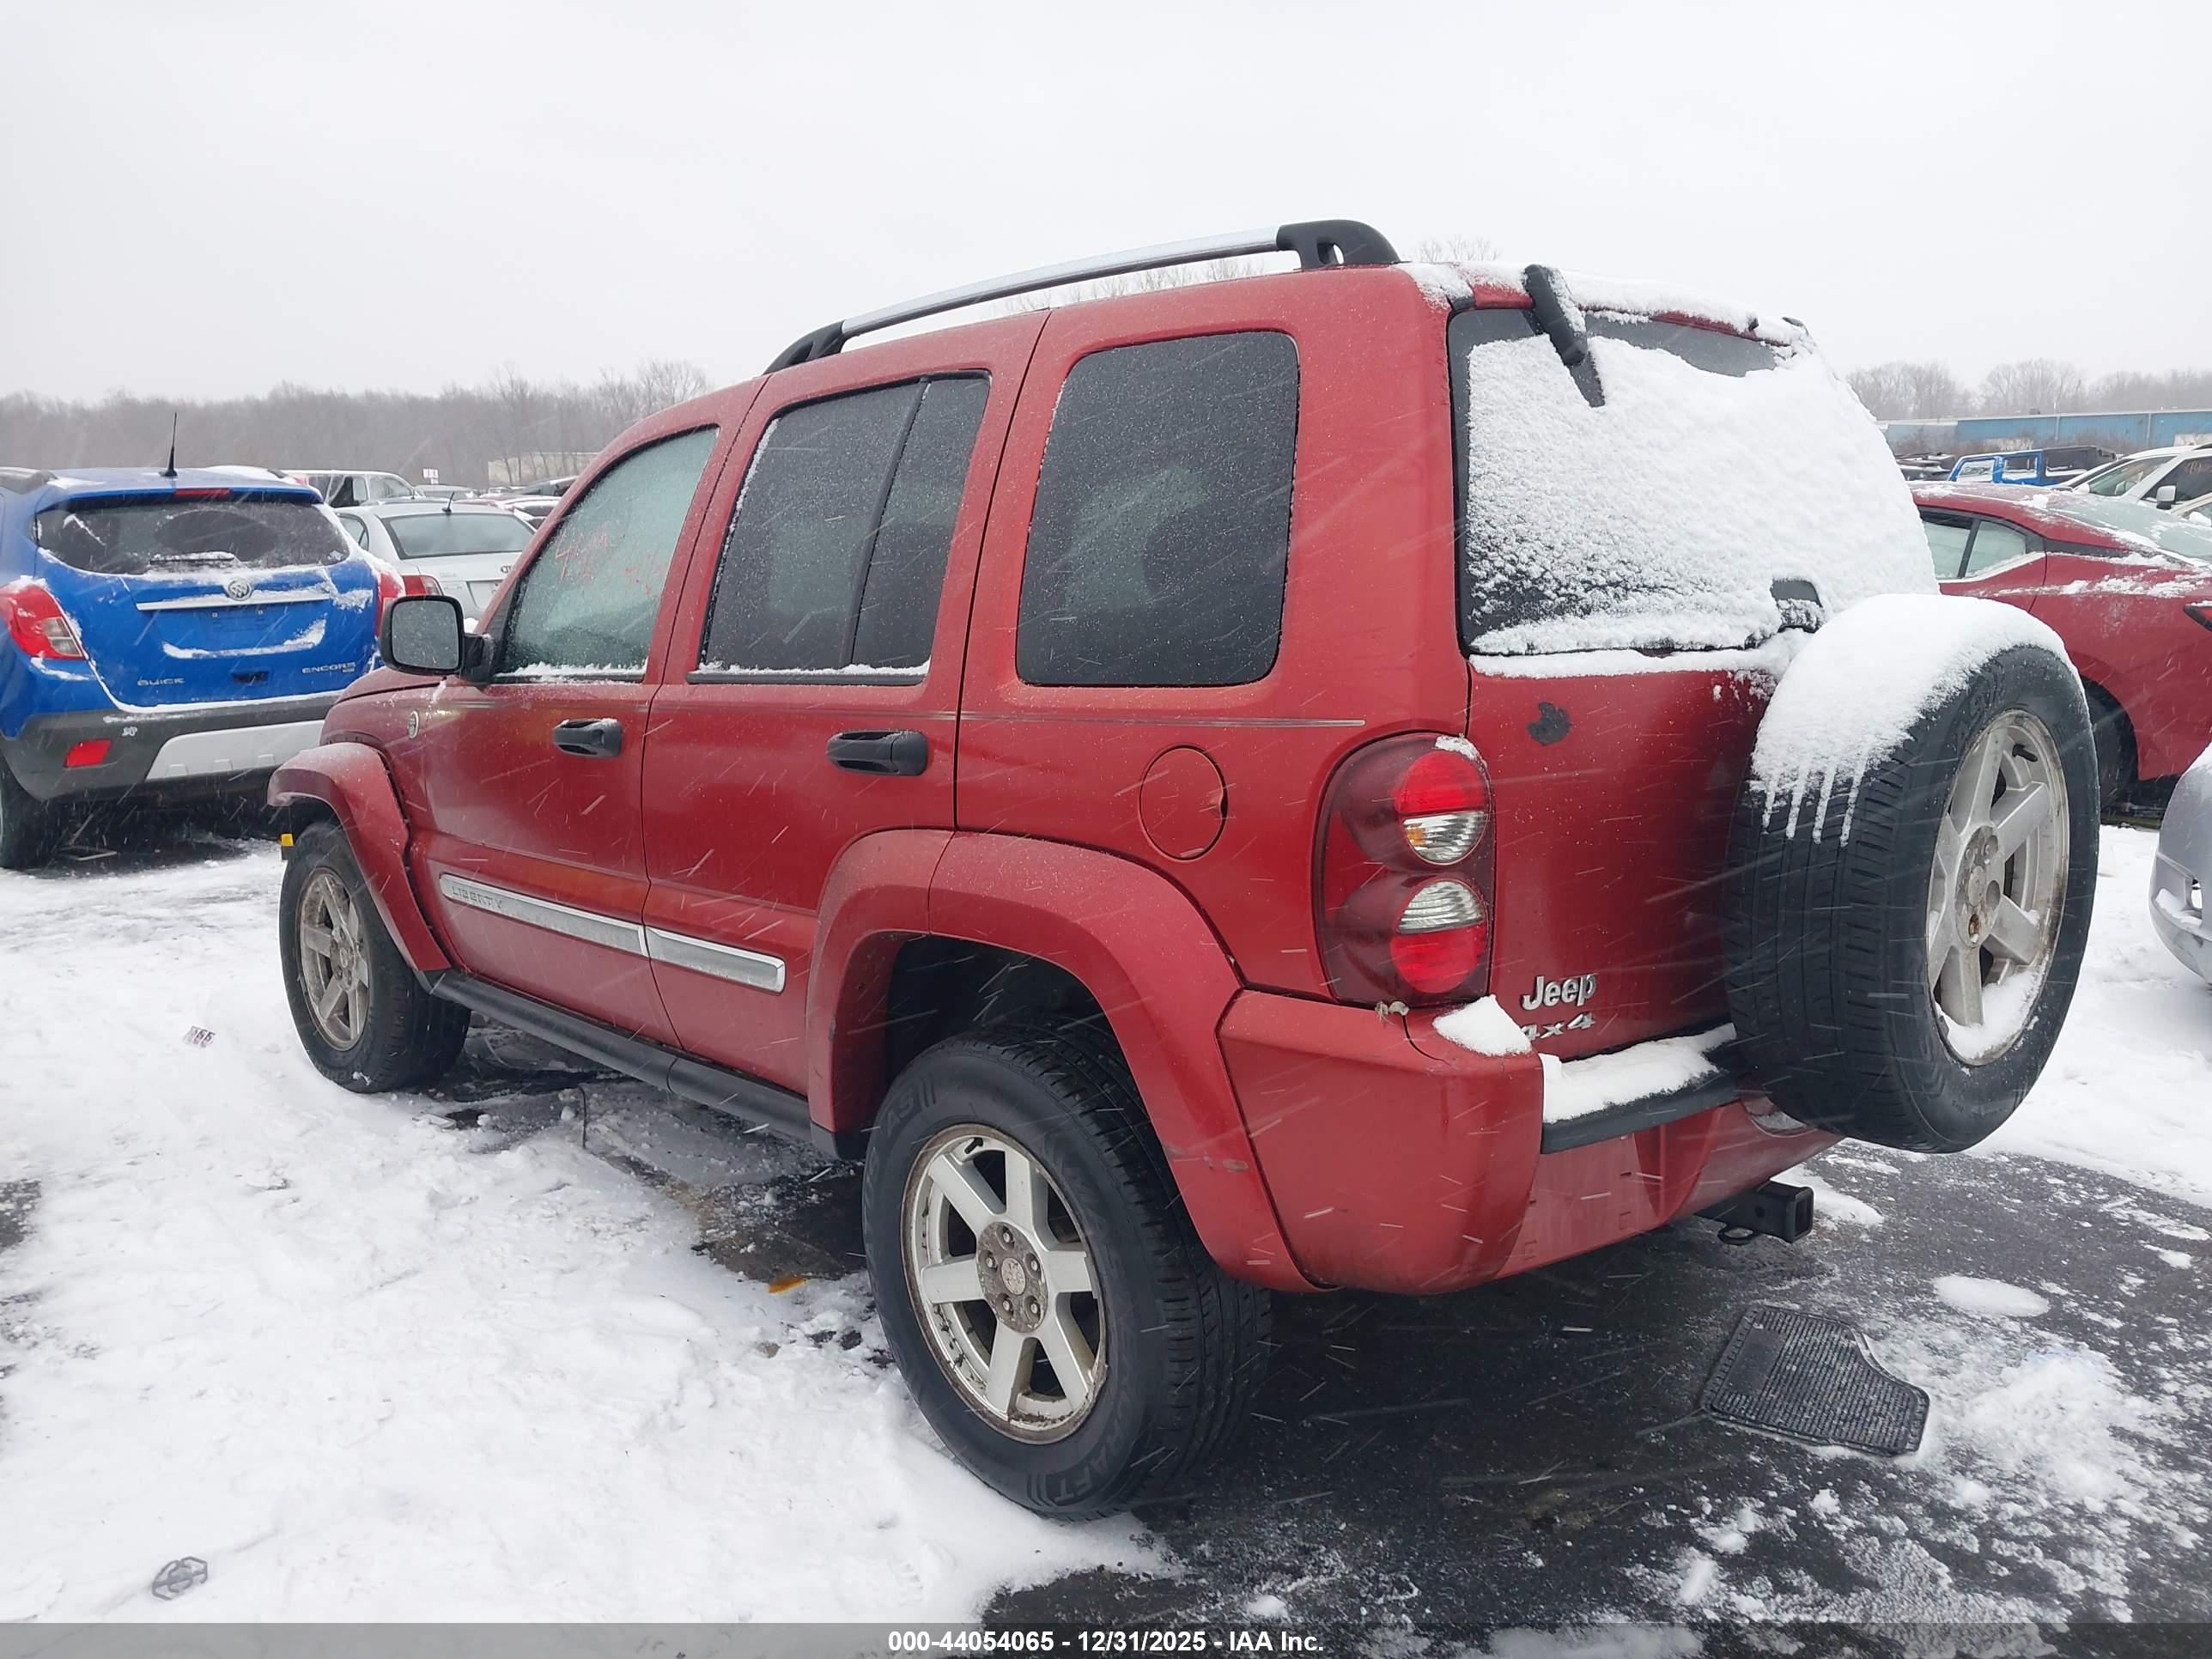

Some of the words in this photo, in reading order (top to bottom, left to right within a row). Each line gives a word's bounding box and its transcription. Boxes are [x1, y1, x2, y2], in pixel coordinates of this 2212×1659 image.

[302, 661, 356, 673] ENCORE
[137, 678, 185, 686] BUICK
[452, 885, 502, 908] LIBERTY
[1521, 974, 1596, 1011] Jeep
[1521, 1012, 1596, 1041] 4x4
